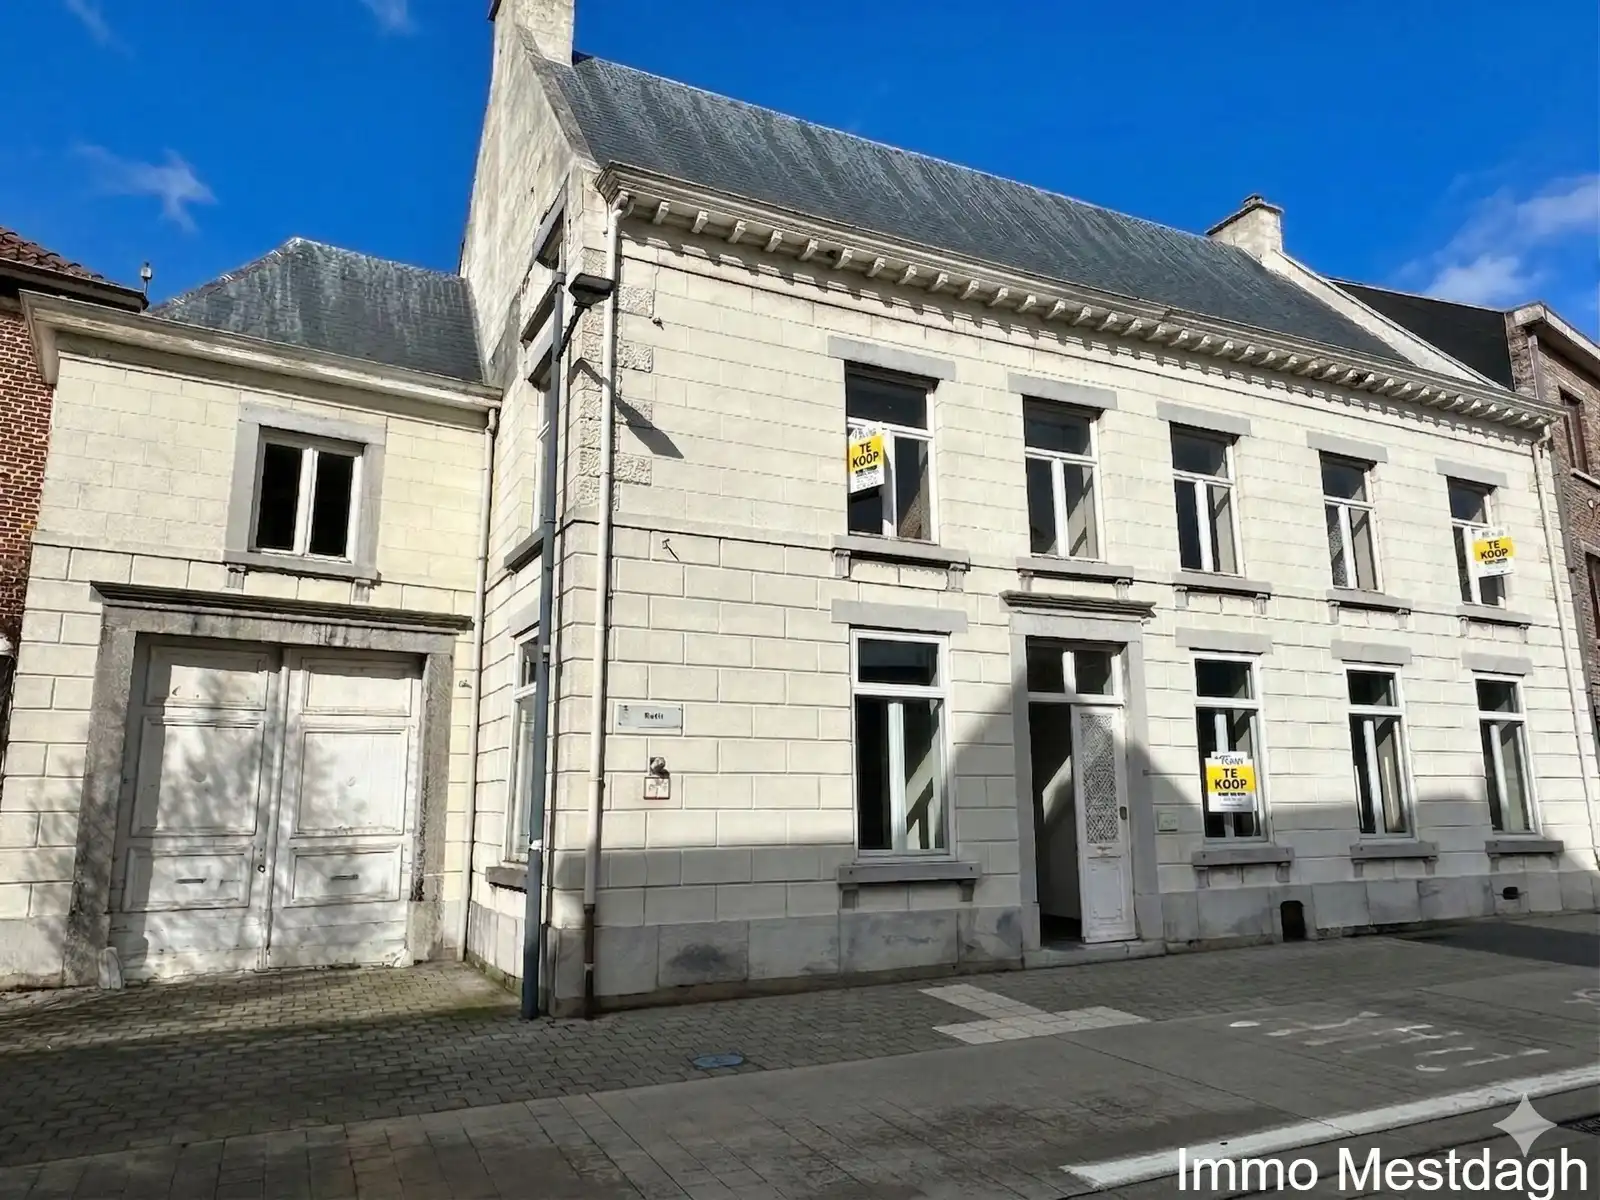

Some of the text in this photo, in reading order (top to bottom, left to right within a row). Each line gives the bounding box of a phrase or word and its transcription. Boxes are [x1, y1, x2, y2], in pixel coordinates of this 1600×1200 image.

[859, 441, 872, 454] TE
[852, 451, 879, 468] KOOP
[1486, 540, 1500, 549] TE
[1480, 548, 1508, 559] KOOP
[1222, 768, 1237, 778] TE
[1214, 779, 1247, 789] KOOP
